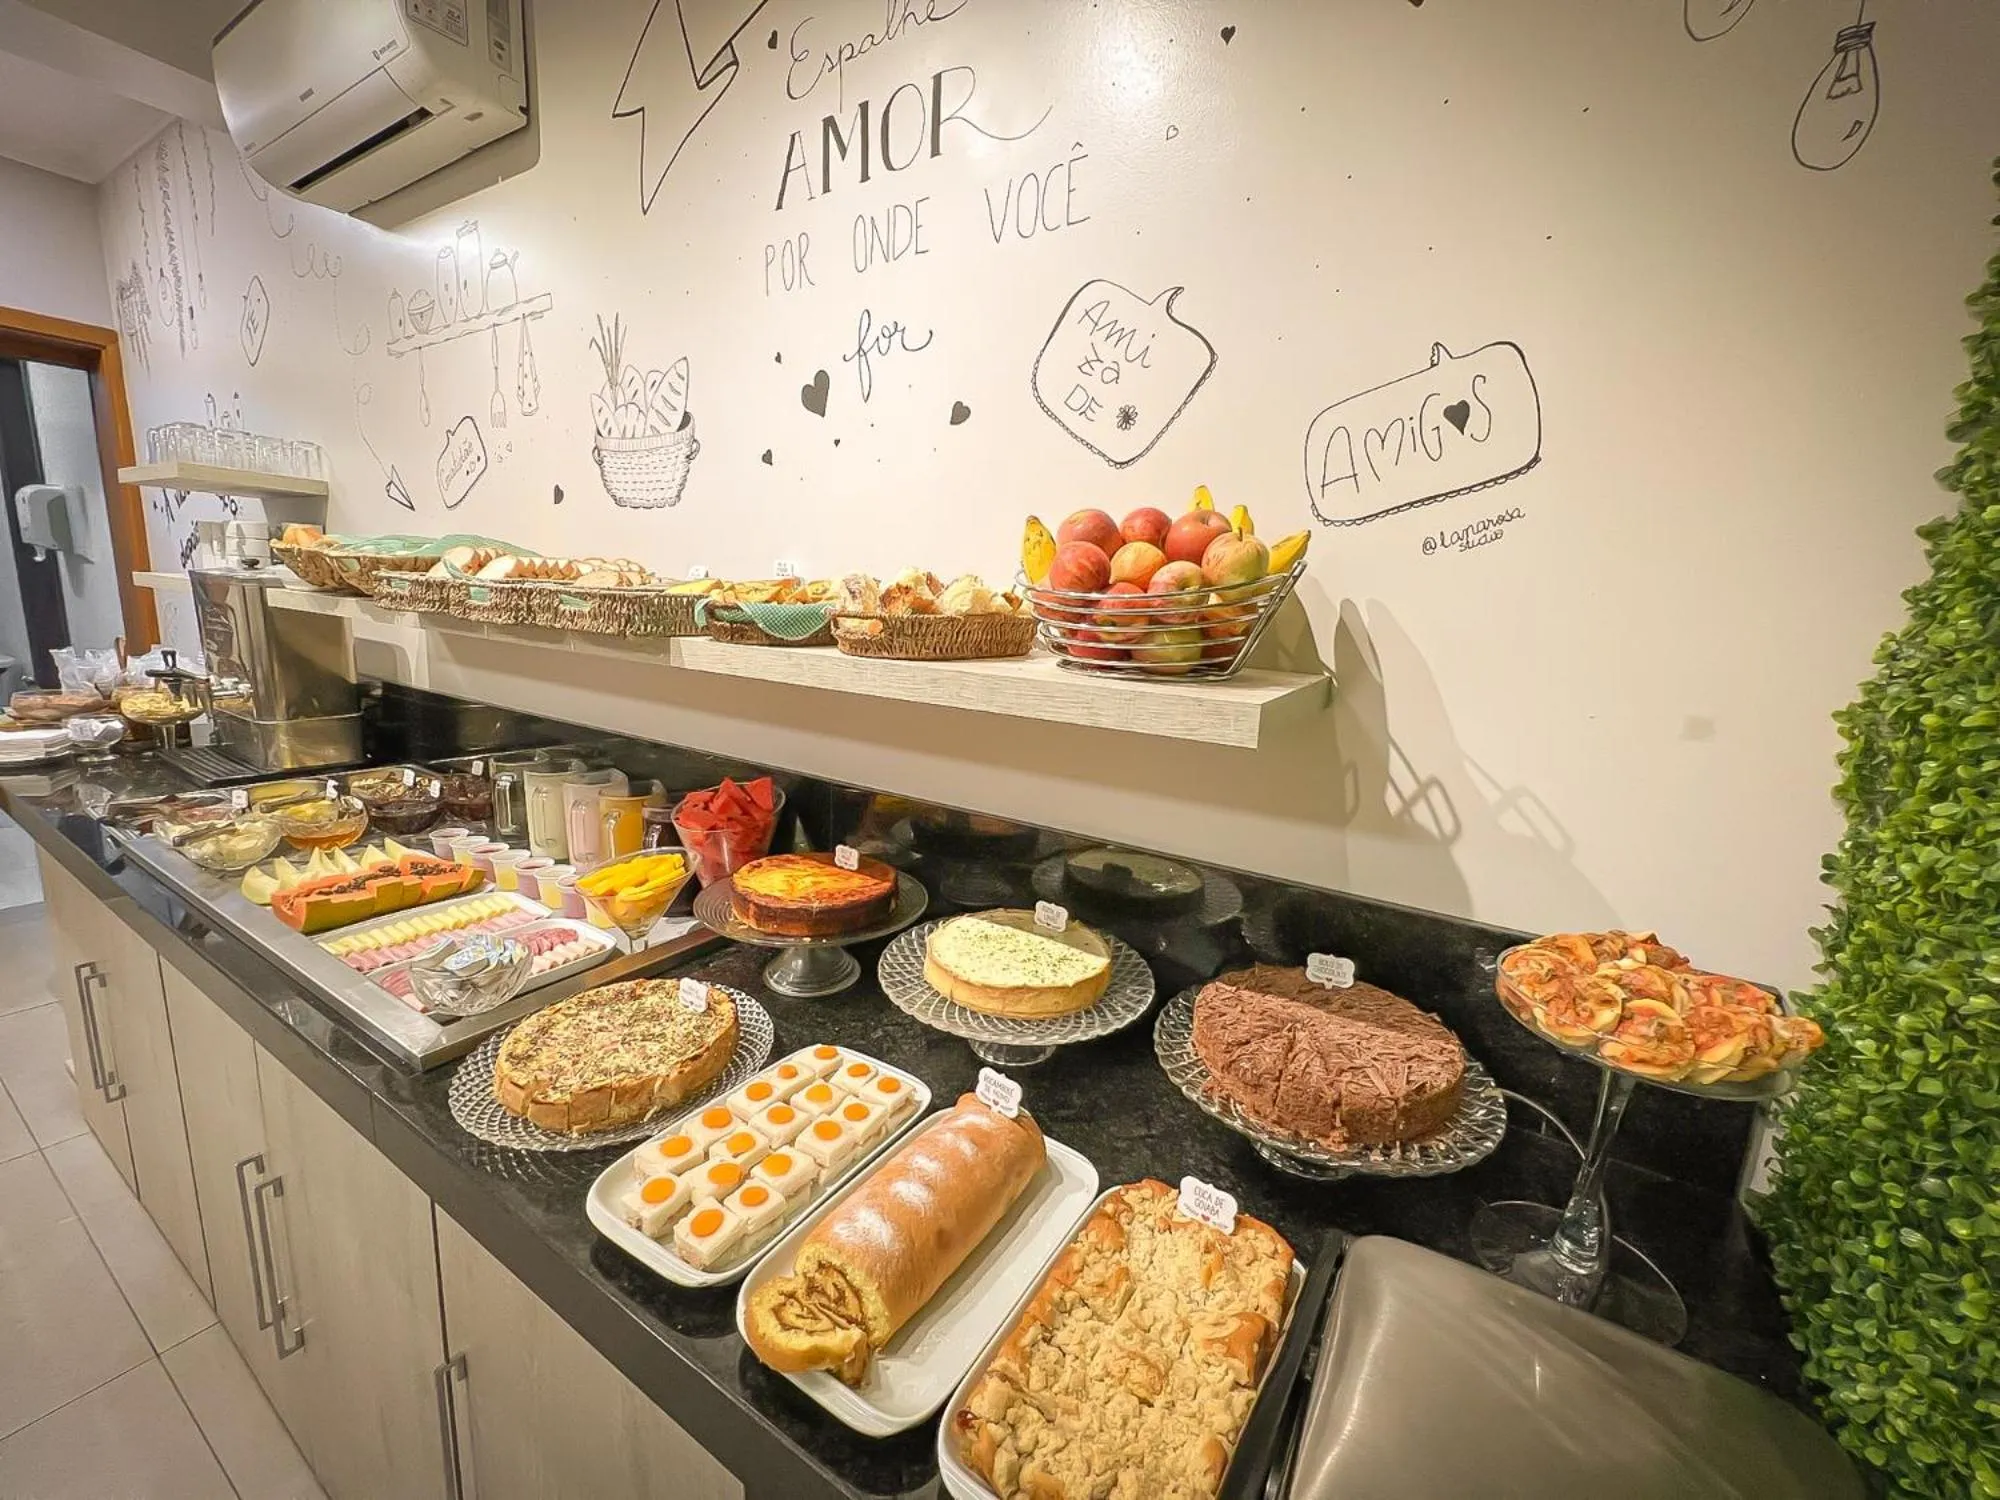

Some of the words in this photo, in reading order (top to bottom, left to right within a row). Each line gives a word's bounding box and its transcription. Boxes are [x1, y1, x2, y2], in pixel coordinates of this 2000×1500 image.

[775, 66, 1053, 211] AMOR
[764, 232, 815, 297] POR
[852, 196, 930, 273] ONDE
[984, 141, 1092, 244] VOCÊ
[842, 308, 934, 404] for
[1063, 384, 1104, 422] DE
